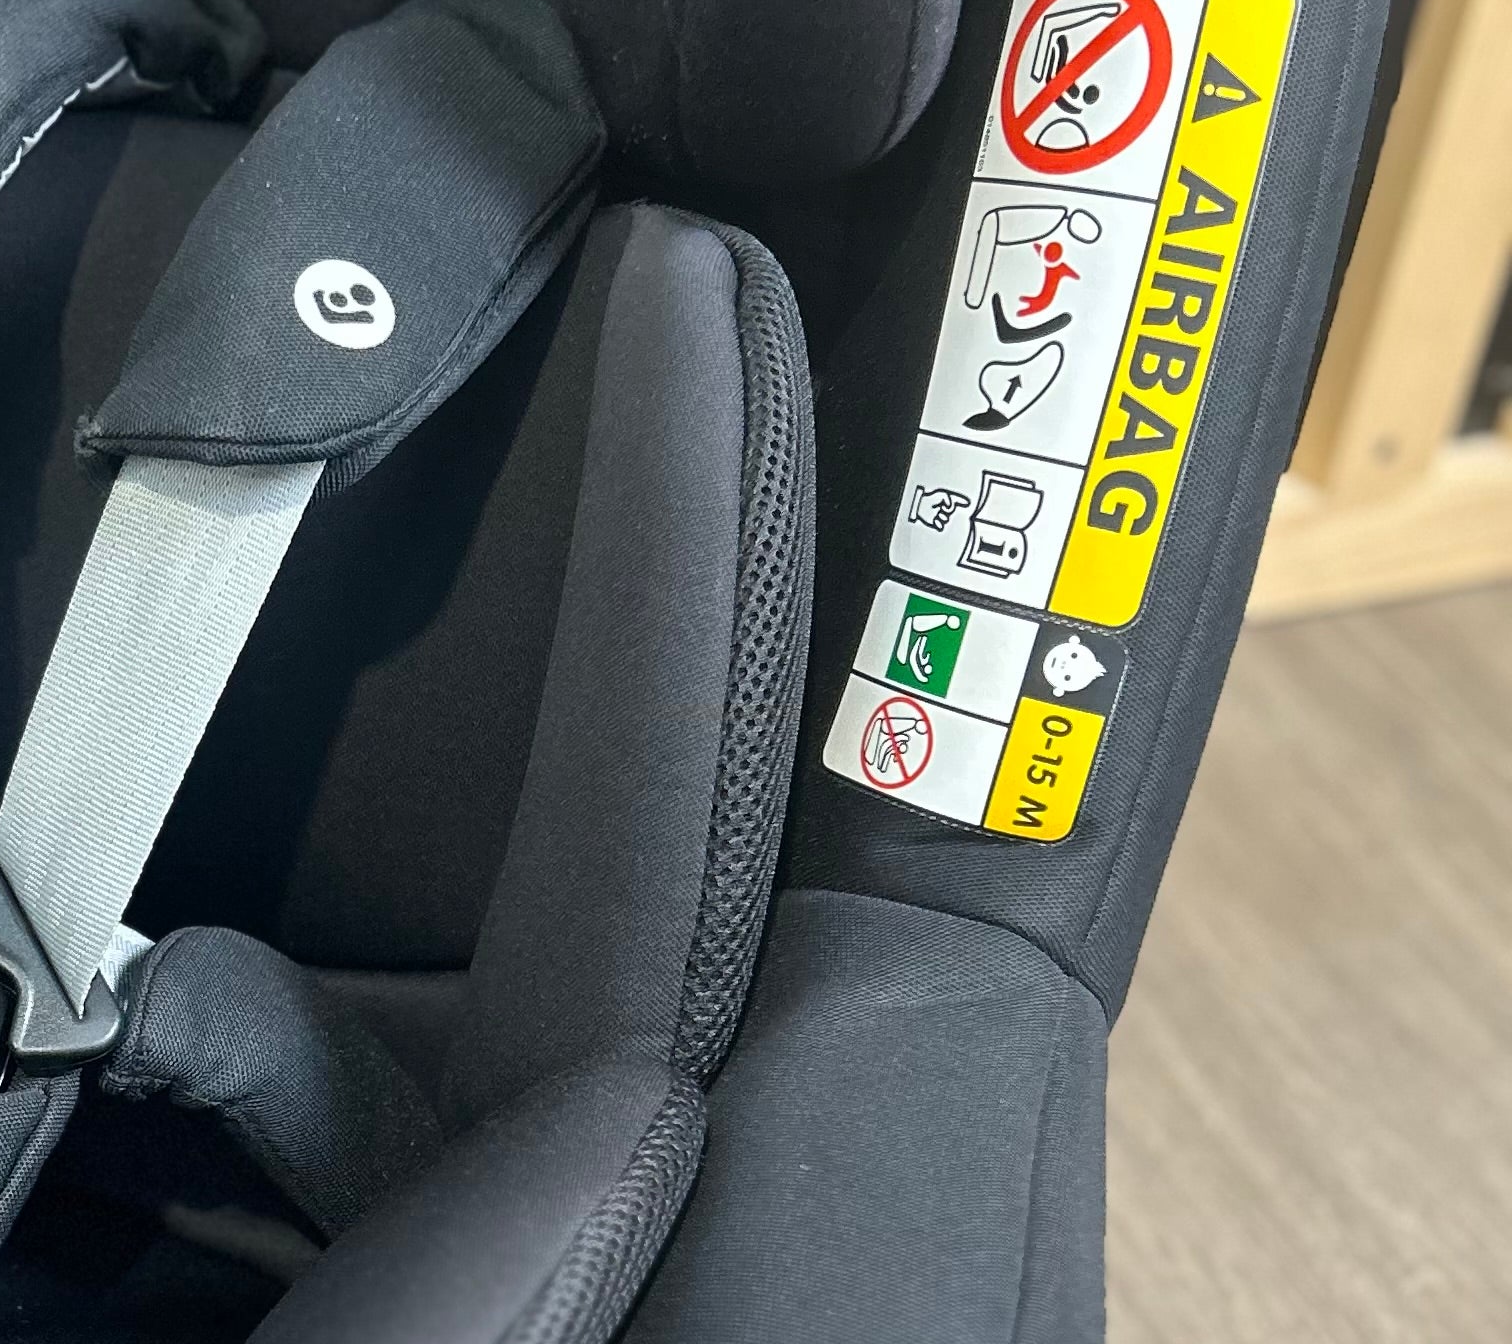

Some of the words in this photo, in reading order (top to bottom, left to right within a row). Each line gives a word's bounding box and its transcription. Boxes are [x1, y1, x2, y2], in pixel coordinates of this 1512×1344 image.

[1086, 166, 1238, 538] AIRBAG
[1026, 715, 1073, 788] 0-15
[1012, 795, 1048, 828] M
